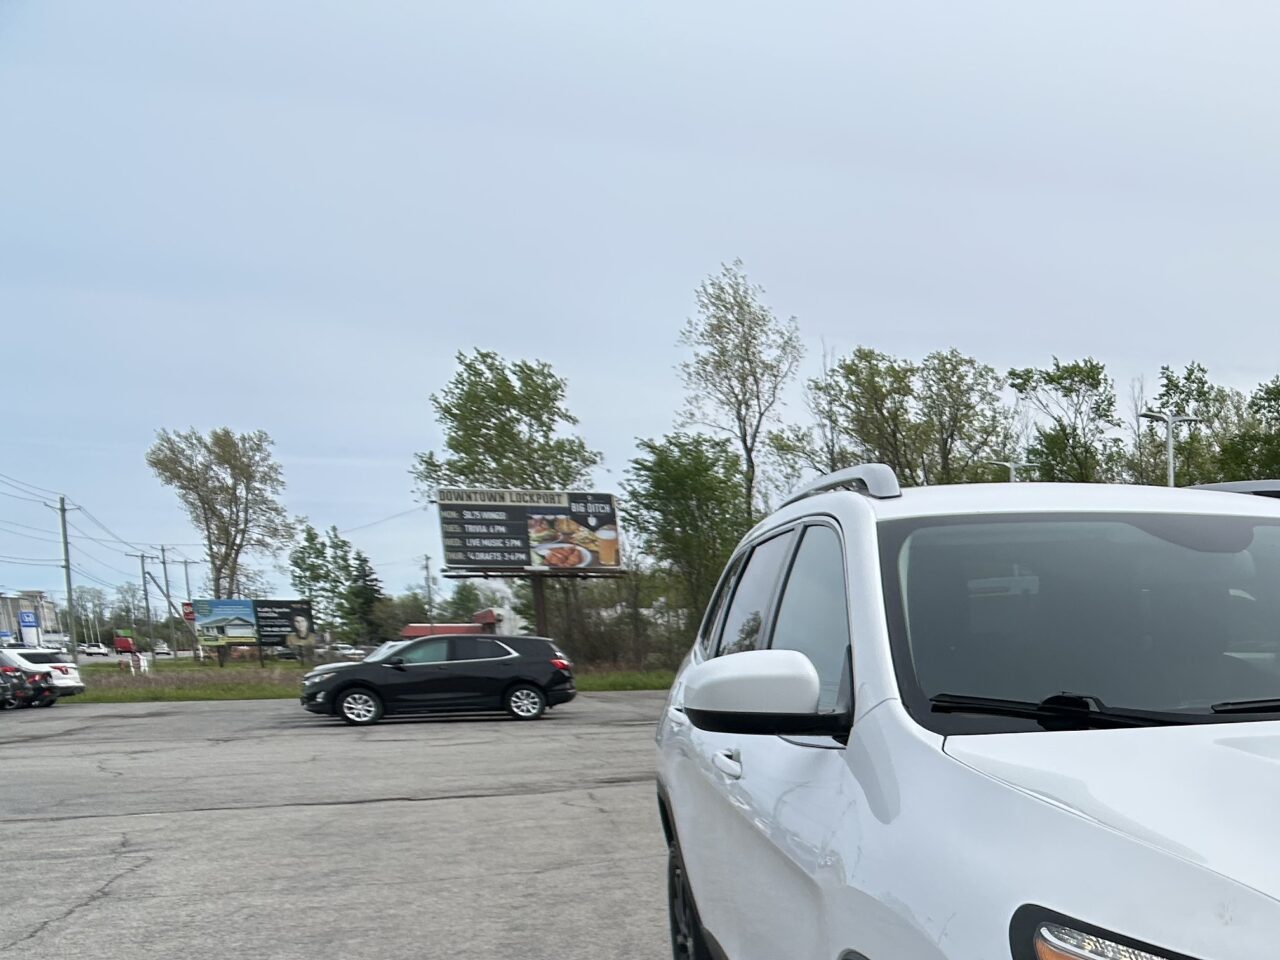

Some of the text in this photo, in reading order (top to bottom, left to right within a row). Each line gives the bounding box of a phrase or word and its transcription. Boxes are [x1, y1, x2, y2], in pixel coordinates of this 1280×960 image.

[440, 490, 563, 505] DOWNTOWN LOCKPORT
[570, 502, 611, 514] BIG DITCH
[465, 538, 481, 547] LIVE
[510, 538, 522, 547] PM
